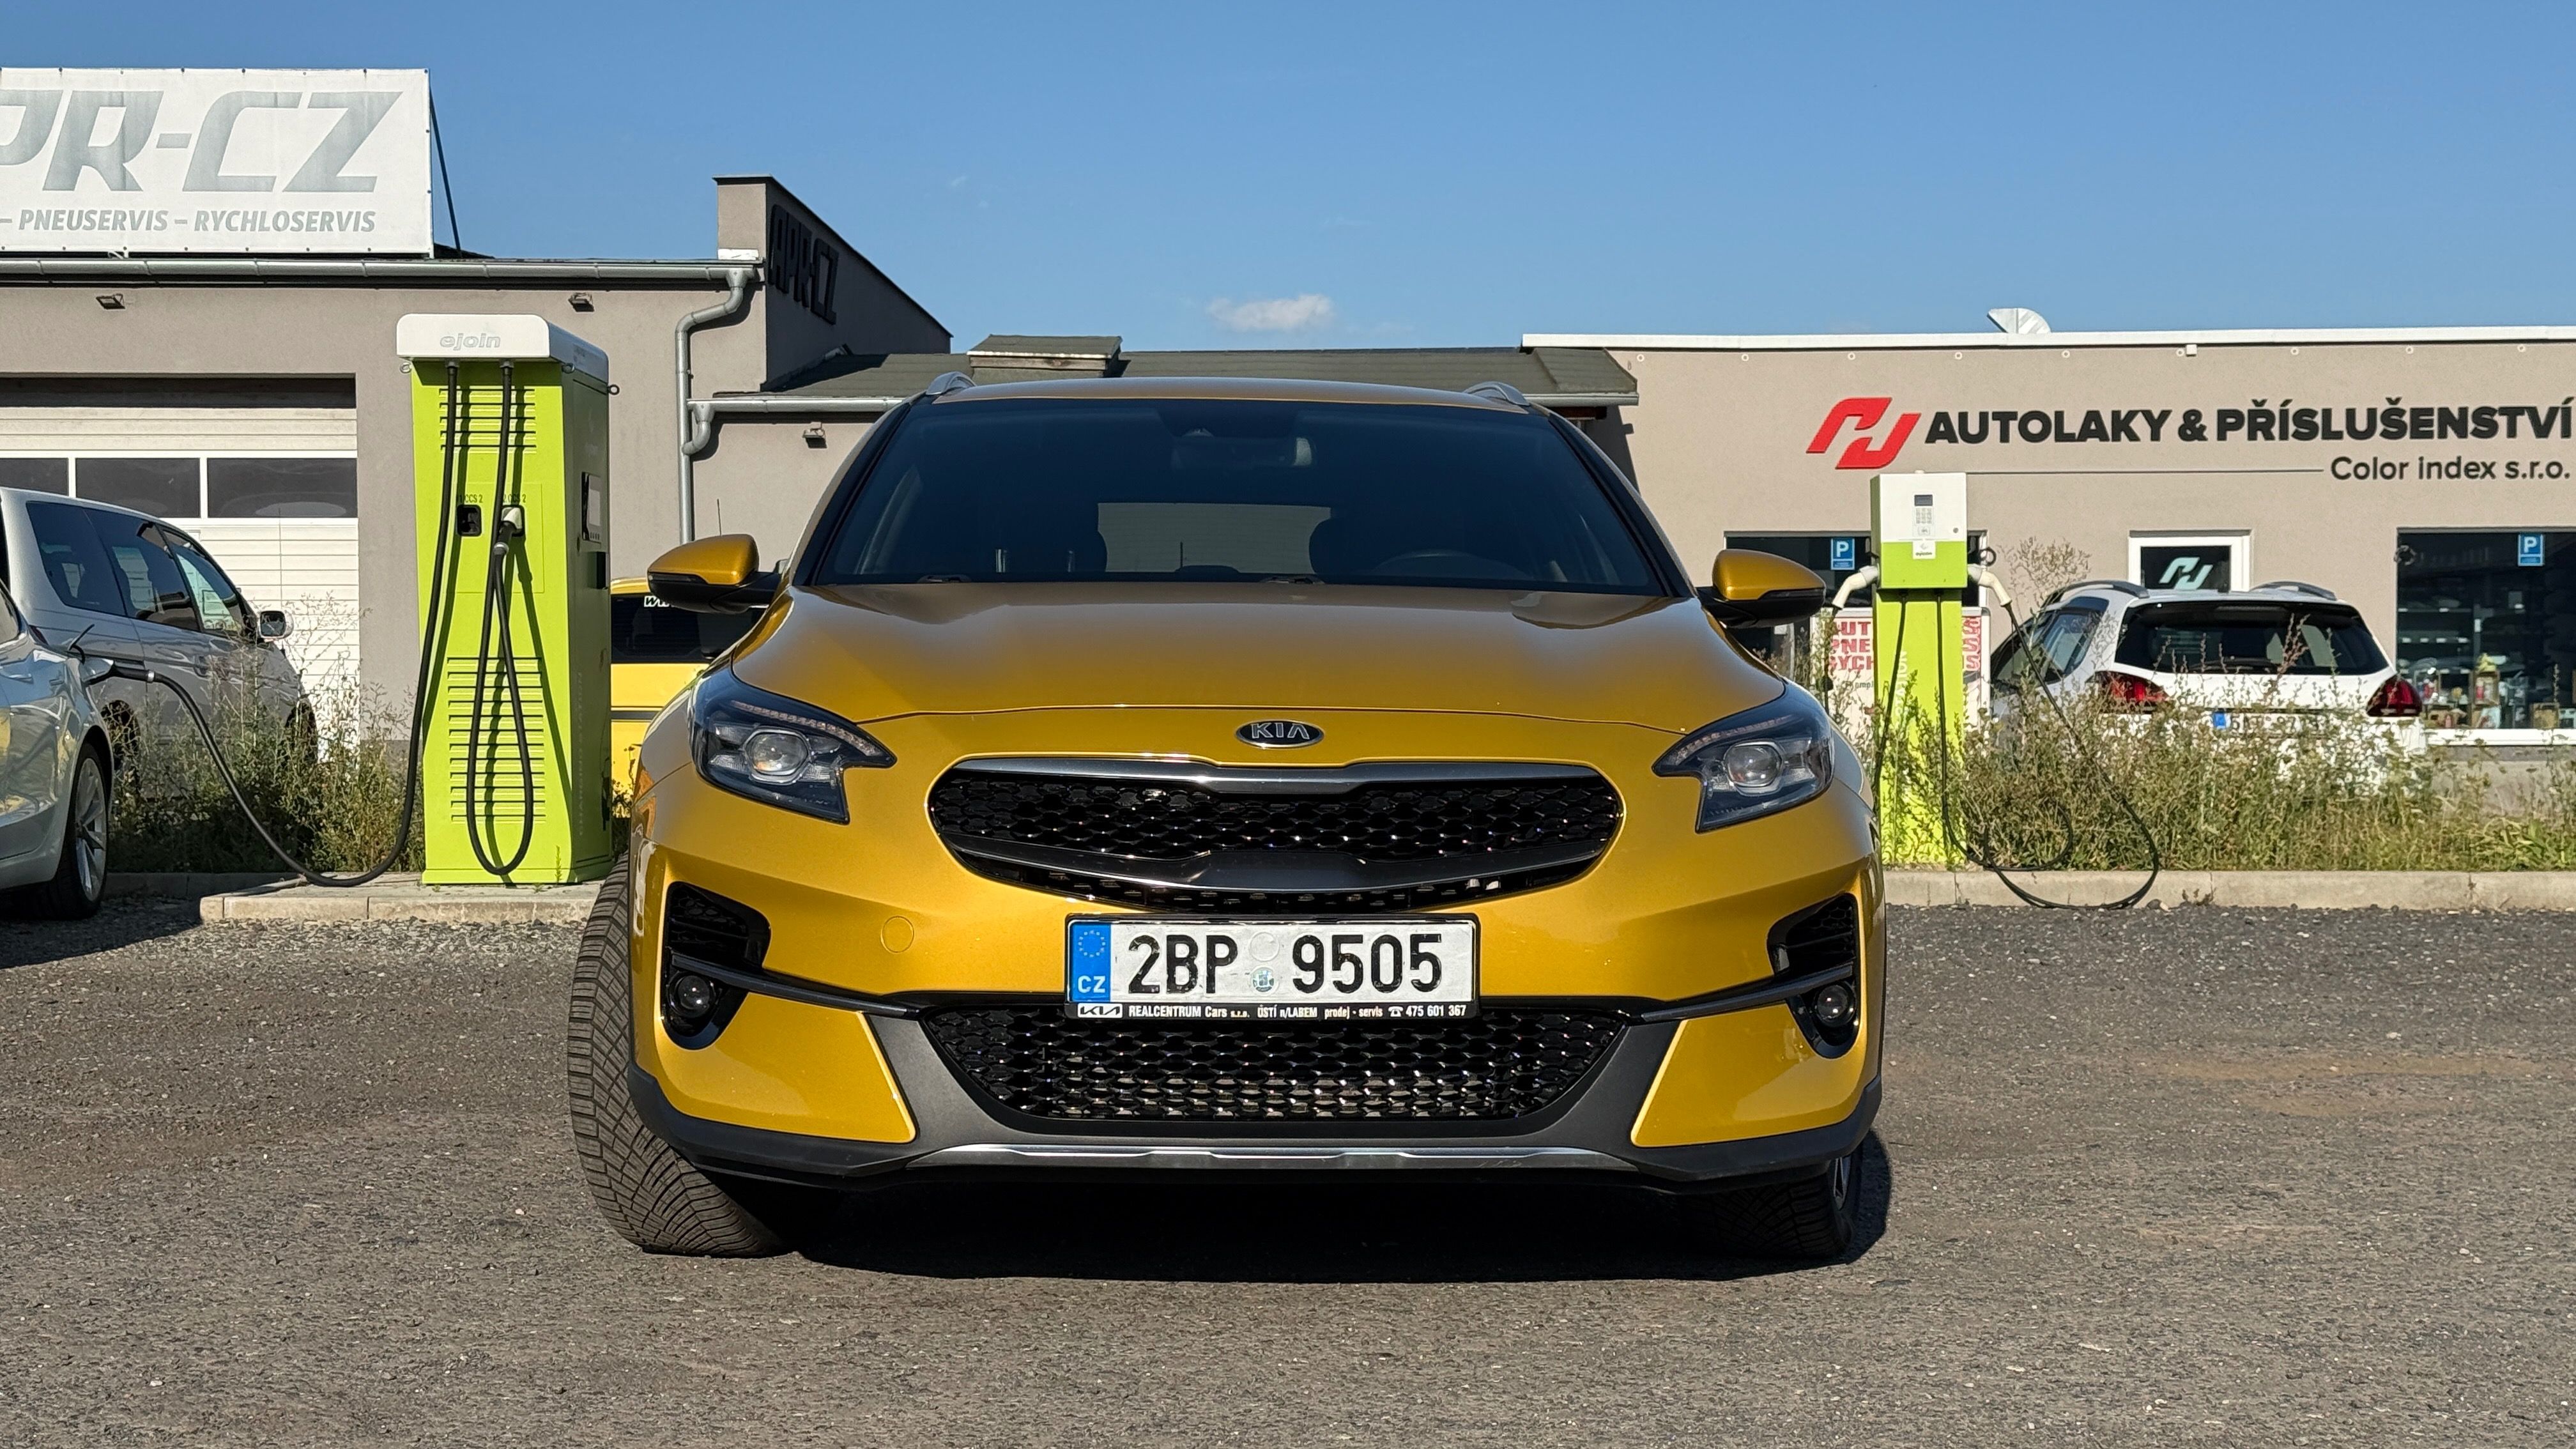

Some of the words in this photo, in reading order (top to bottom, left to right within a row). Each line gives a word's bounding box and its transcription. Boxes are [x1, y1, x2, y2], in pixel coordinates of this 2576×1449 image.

[18, 210, 169, 231] PNEUSERVIS
[194, 210, 376, 233] RYCHLOSERVIS
[440, 333, 501, 351] ejoin
[1924, 410, 2172, 443] AUTOLAKY
[2178, 409, 2208, 442] &
[2216, 397, 2574, 441] PŘÍSLUŠENSTVÍ
[2331, 456, 2409, 480] Color
[2418, 456, 2496, 480] index
[2504, 460, 2570, 480] s.r.o.
[1836, 541, 1849, 558] P
[2524, 537, 2537, 553] P
[1250, 722, 1310, 740] KIA
[1077, 975, 1105, 994] CZ
[1128, 933, 1238, 994] 2BP
[1292, 933, 1442, 994] 9505
[1129, 1005, 1201, 1018] REALCENTRUM
[1205, 1005, 1227, 1018] Cars
[1324, 1006, 1350, 1020] prodej
[1358, 1006, 1383, 1017] servis
[1405, 1005, 1424, 1017] 475
[1427, 1005, 1445, 1016] 601
[1448, 1004, 1466, 1016] 367
